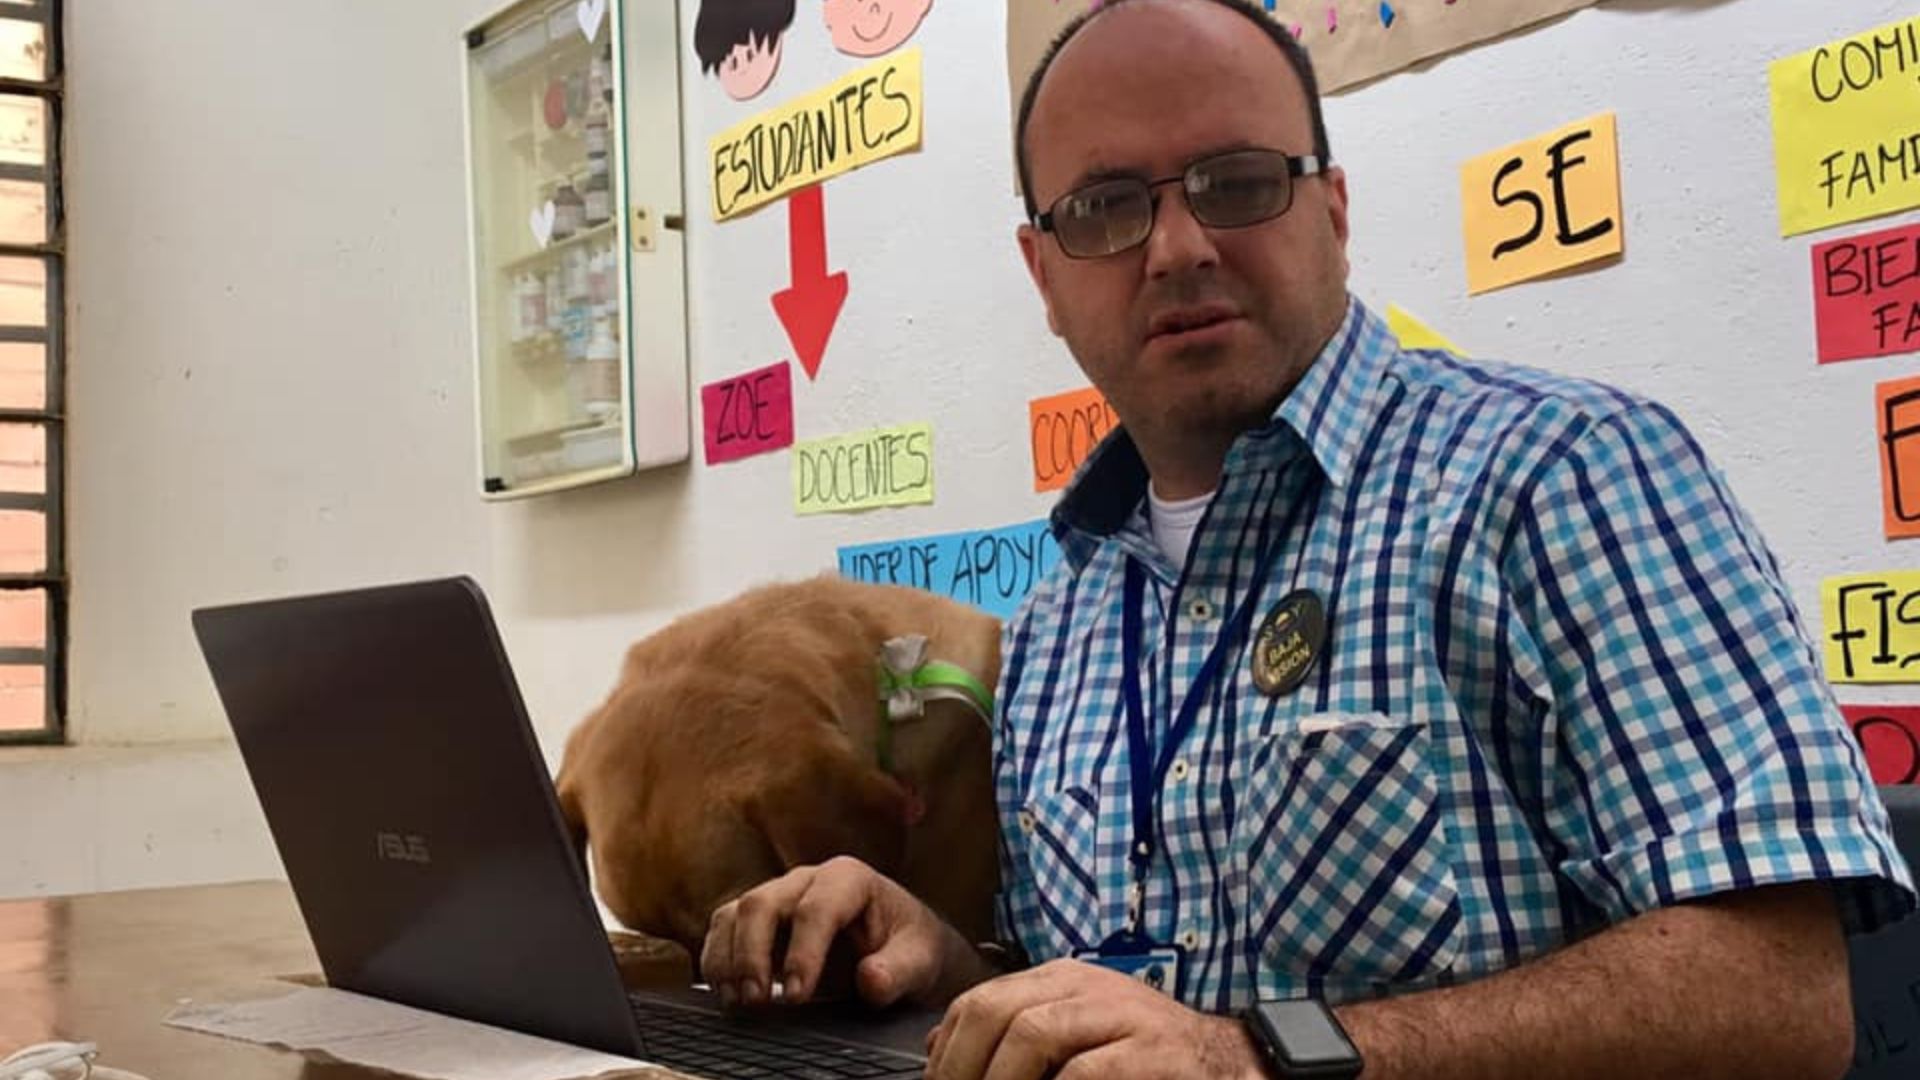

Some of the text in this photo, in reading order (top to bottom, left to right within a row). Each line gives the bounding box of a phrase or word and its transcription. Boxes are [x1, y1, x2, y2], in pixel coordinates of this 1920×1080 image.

[1811, 23, 1920, 102] COMI
[714, 67, 913, 216] ESTUDIANTES
[1491, 130, 1614, 261] SE
[1824, 236, 1920, 297] BIE
[716, 372, 775, 445] ZOE
[1032, 399, 1111, 482] COOR
[800, 432, 929, 504] DOCENTES
[1268, 630, 1302, 666] BAJA
